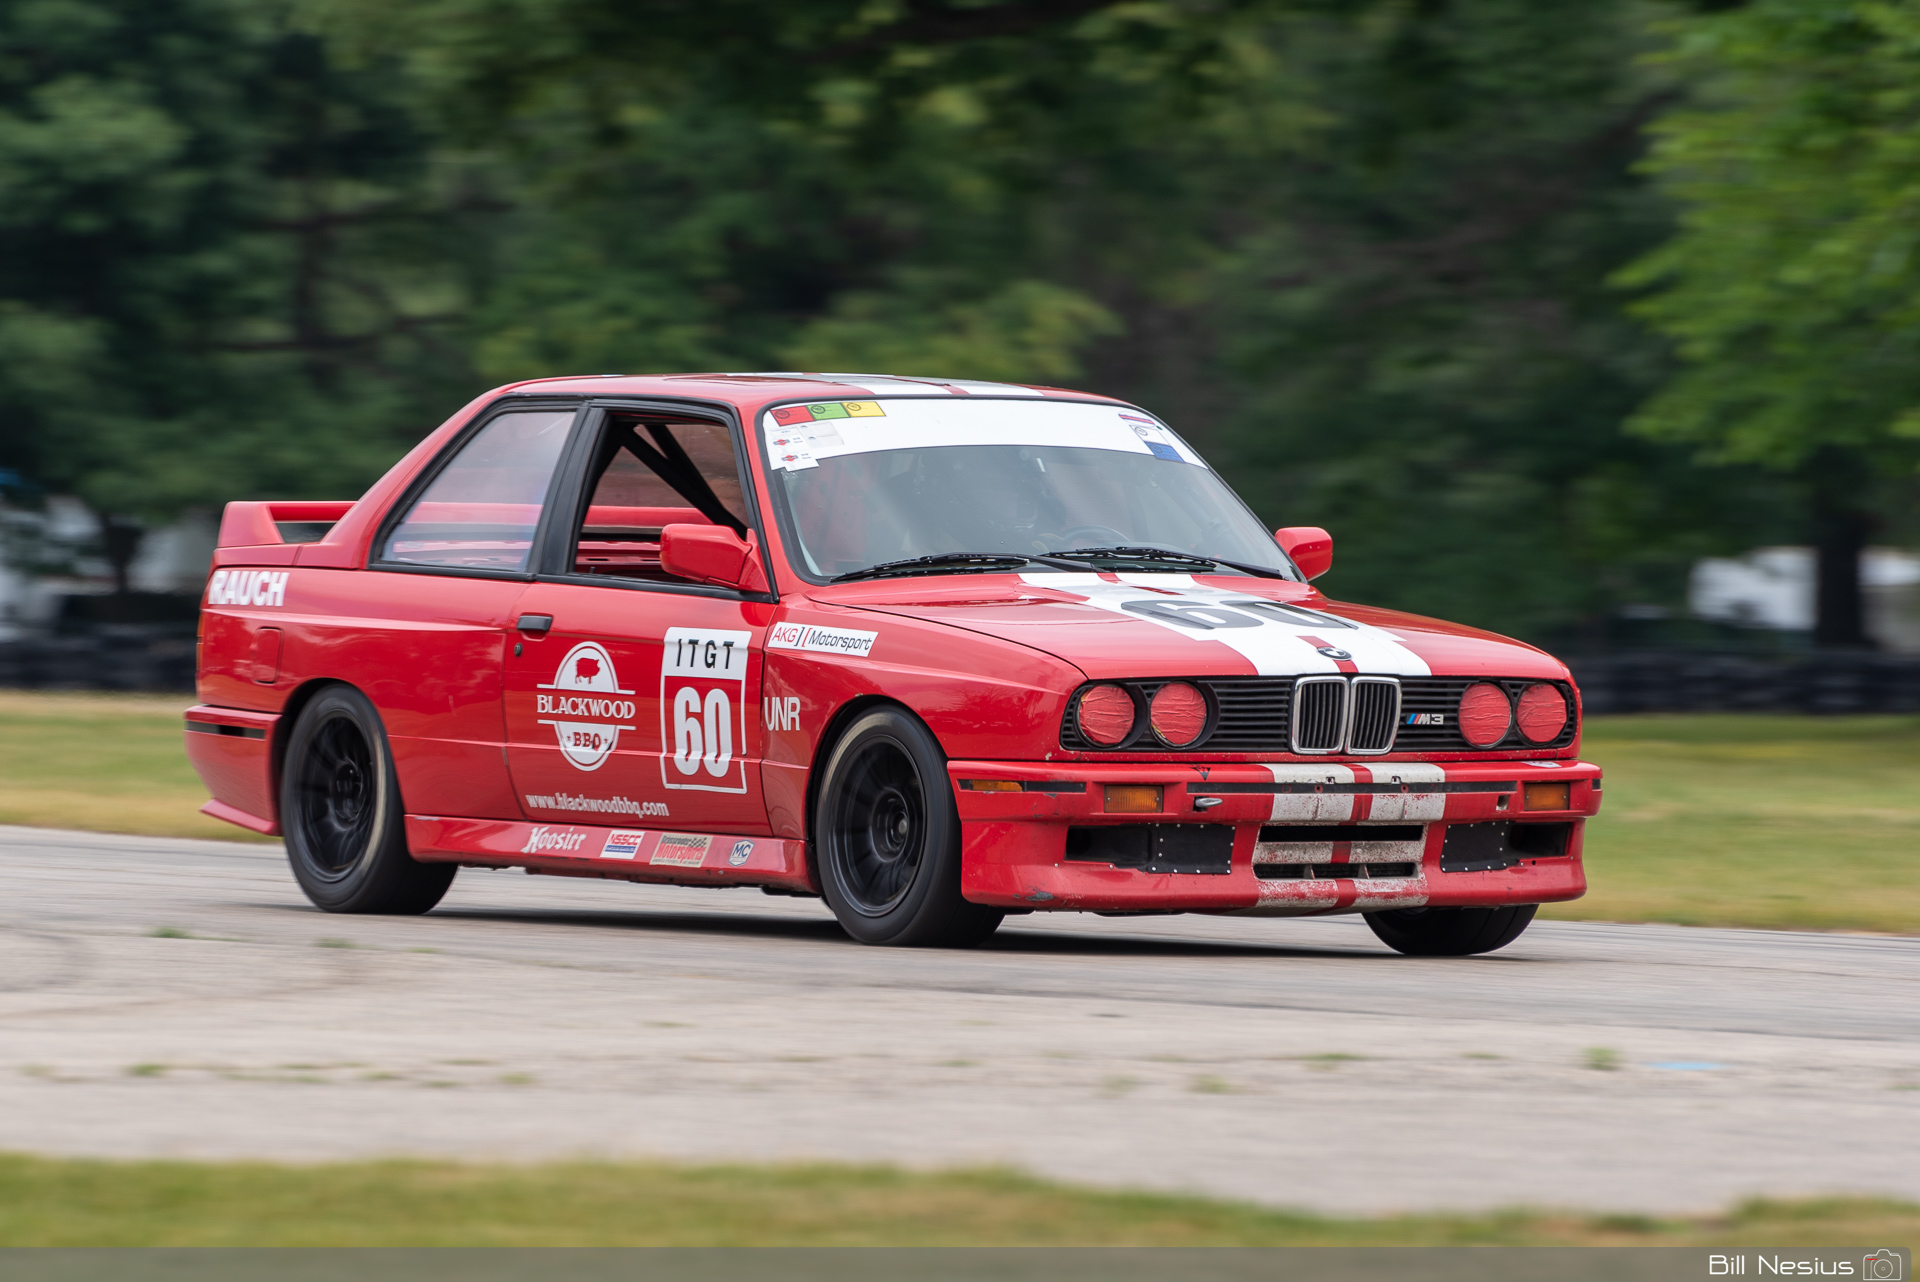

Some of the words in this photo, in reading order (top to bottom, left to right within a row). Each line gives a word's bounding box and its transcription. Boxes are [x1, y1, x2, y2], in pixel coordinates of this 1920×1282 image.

[208, 570, 290, 607] RAUCH
[1120, 599, 1360, 630] 60
[536, 694, 636, 719] BLACKWOOD
[764, 696, 801, 731] UNR
[1417, 713, 1444, 725] M3
[573, 731, 601, 751] BBQ
[673, 686, 733, 777] 60
[525, 792, 670, 819] www.blackwoodbbq.com
[520, 825, 587, 854] Hoosier
[654, 842, 706, 864] Motorsports
[732, 843, 751, 858] MC
